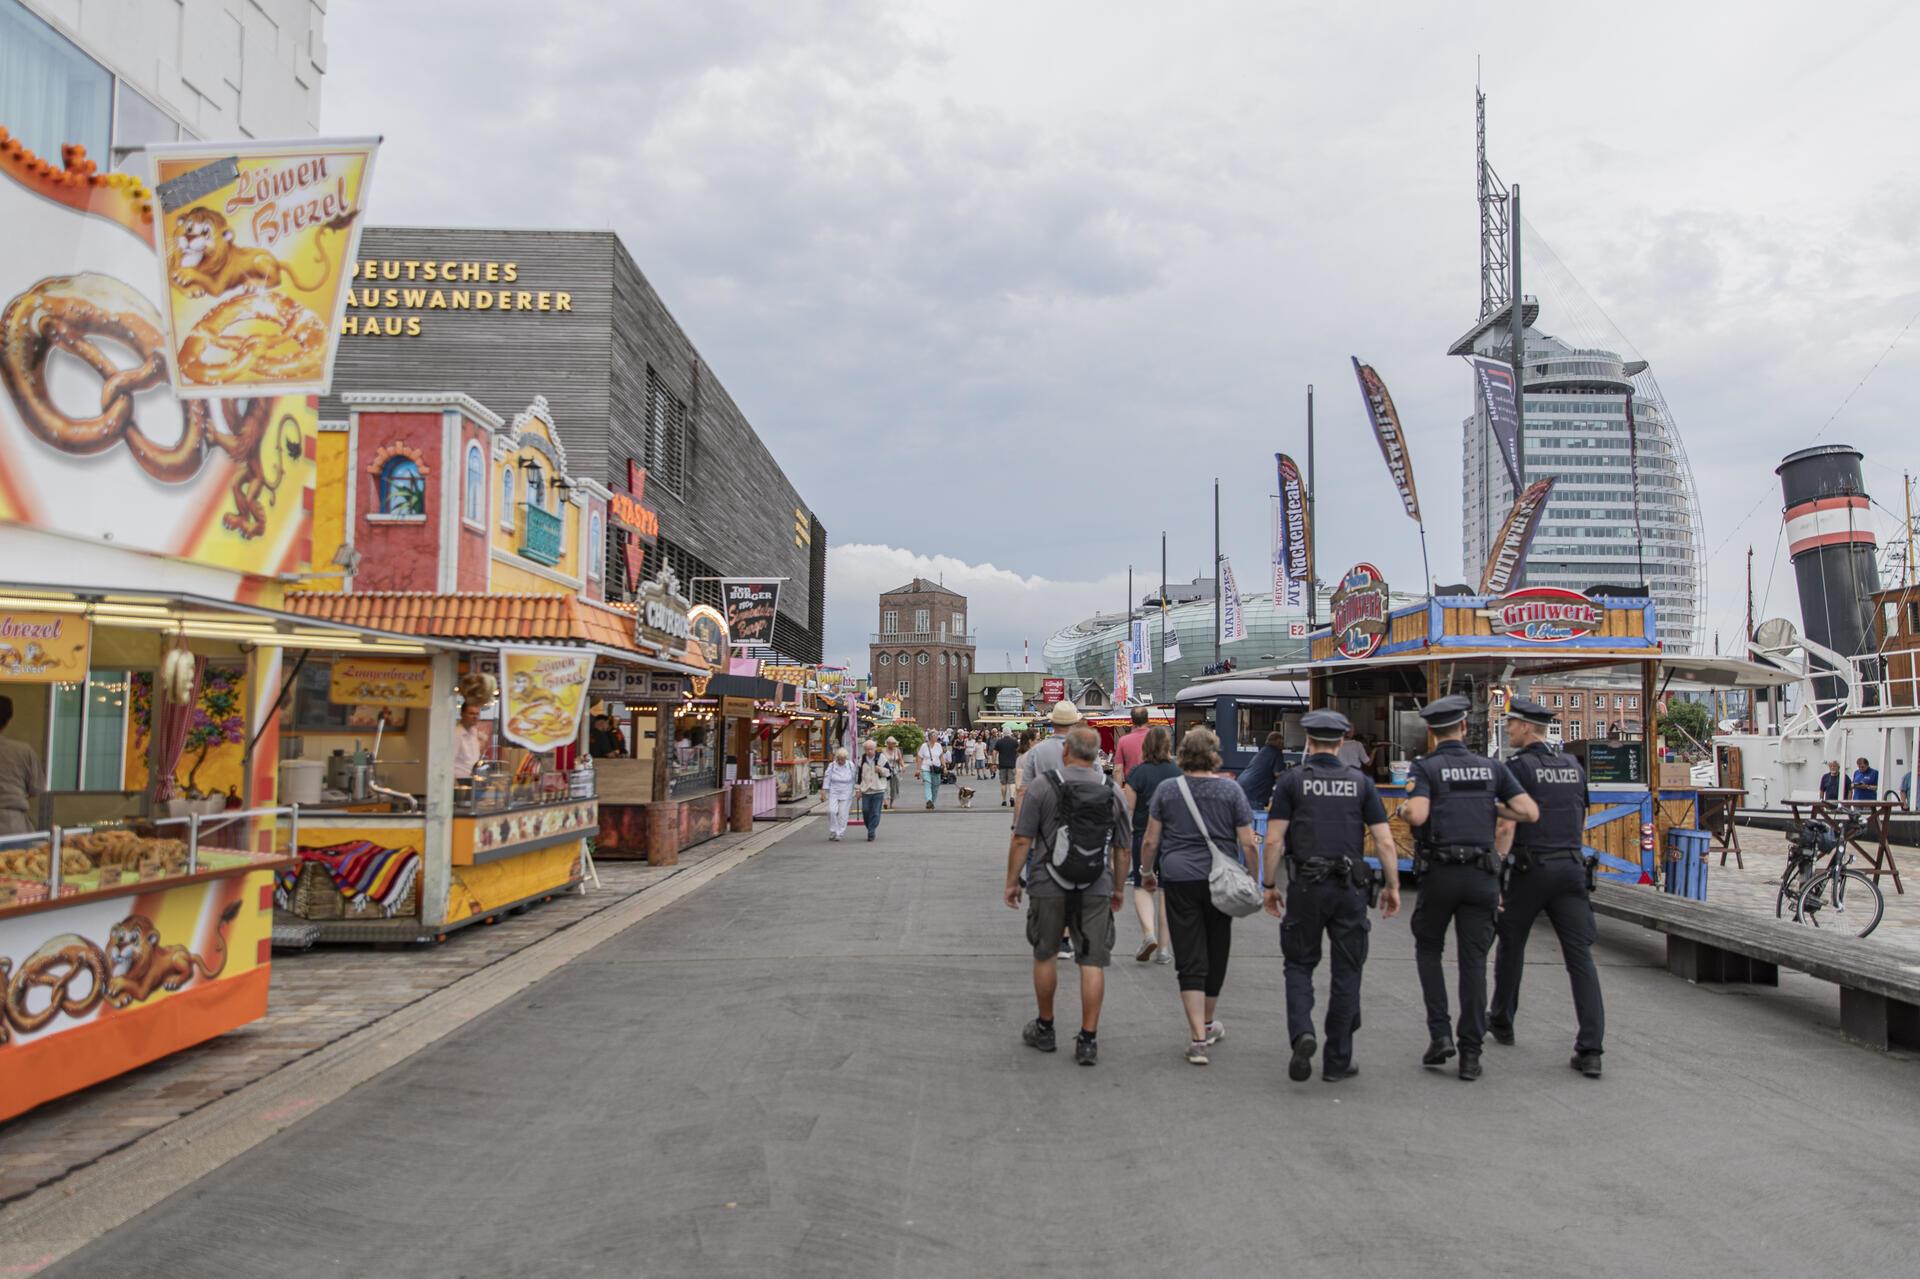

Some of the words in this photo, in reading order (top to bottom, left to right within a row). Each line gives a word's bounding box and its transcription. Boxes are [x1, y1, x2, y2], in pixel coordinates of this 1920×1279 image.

[225, 155, 329, 214] Löwen
[251, 175, 350, 247] Brezel
[345, 288, 573, 311] AUSWANDERER
[341, 316, 421, 336] HAUS
[1285, 478, 1308, 578] Nackensteak
[1487, 500, 1535, 592] Currywurst
[730, 592, 772, 600] BURGER
[646, 600, 690, 640] CHURROS
[1502, 602, 1596, 626] Grillwerk
[1290, 625, 1305, 636] E2
[1441, 767, 1494, 782] POLIZEI
[1535, 767, 1580, 784] POLIZEI
[1303, 779, 1358, 797] POLIZEI
